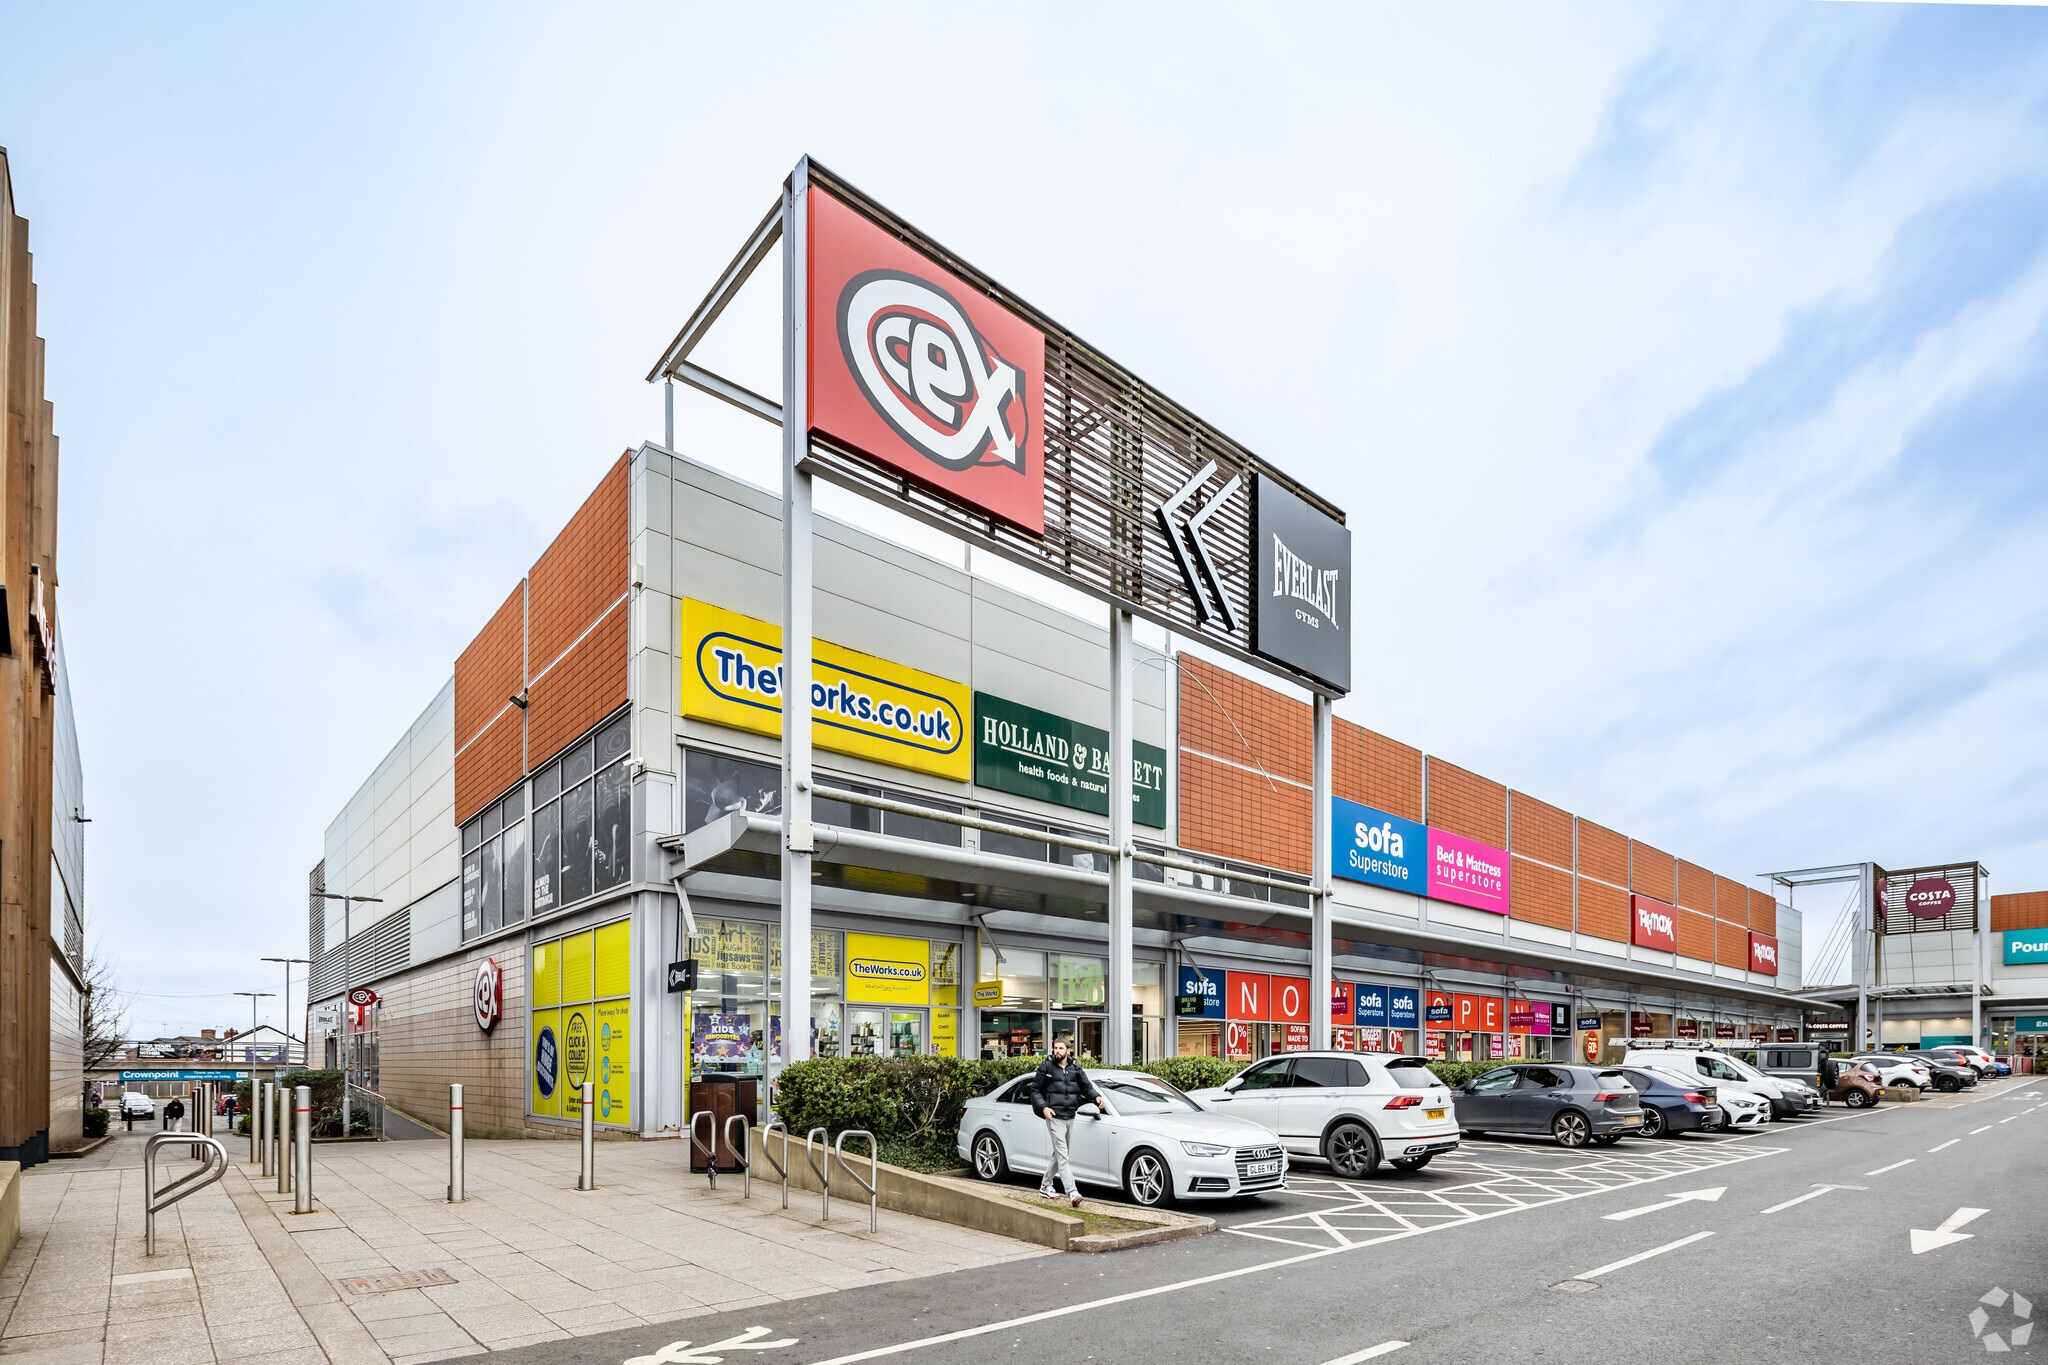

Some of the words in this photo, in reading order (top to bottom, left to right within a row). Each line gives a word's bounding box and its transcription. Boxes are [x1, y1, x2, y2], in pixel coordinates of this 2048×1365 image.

[1272, 532, 1340, 629] EVERLAST
[1295, 609, 1320, 630] GYMS
[714, 648, 952, 742] Theorks.co.uk
[982, 715, 1069, 762] HOLLAND
[1072, 742, 1088, 771] &
[1091, 747, 1163, 791] BAETT
[1018, 761, 1044, 779] health
[1047, 768, 1069, 785] foods
[1071, 776, 1078, 787] &
[1080, 779, 1107, 794] natural
[1355, 821, 1404, 859] sofa
[1349, 850, 1409, 881] Superstore
[1436, 844, 1455, 864] Bed
[1456, 851, 1464, 866] &
[1465, 852, 1502, 878] Mattress
[1436, 863, 1502, 891] superstore
[1909, 890, 1951, 902] COSTA
[717, 920, 746, 944] Art
[719, 943, 743, 952] LAUGH
[716, 950, 751, 963] Jigsaws
[853, 962, 922, 978] TheWorks.co.uk
[1186, 977, 1217, 996] sofa
[1360, 992, 1382, 1008] sofa
[1393, 996, 1413, 1010] sofa
[1358, 1007, 1384, 1017] Superstore
[1391, 1009, 1415, 1019] Superstore
[1430, 1007, 1448, 1015] sofa
[571, 1021, 583, 1033] FREE
[711, 1025, 735, 1033] KIDS
[1290, 1025, 1306, 1033] SOFAS
[568, 1035, 581, 1048] CLICK
[581, 1035, 586, 1048] &
[933, 1035, 955, 1043] Stationery
[1227, 1022, 1247, 1049] 0%
[1287, 1034, 1301, 1042] MADE
[1300, 1035, 1308, 1043] TO
[568, 1049, 586, 1061] COLLECT
[123, 1070, 179, 1079] Crownpoint
